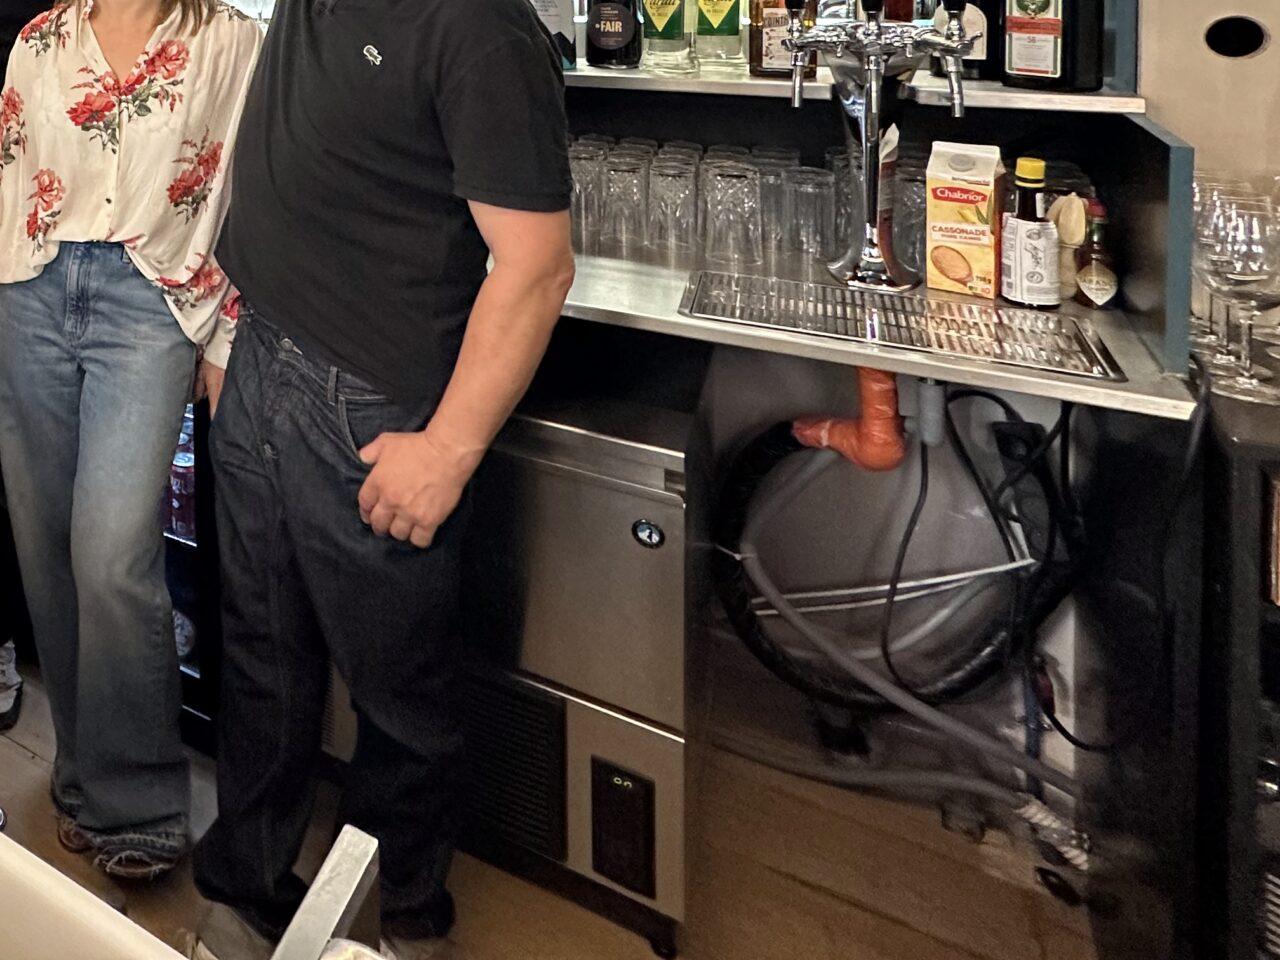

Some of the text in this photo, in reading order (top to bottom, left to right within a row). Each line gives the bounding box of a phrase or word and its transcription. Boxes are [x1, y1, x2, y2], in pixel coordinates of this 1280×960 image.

[600, 21, 623, 33] FAIR
[936, 188, 985, 202] Chabrior
[931, 225, 987, 236] CASSONADE
